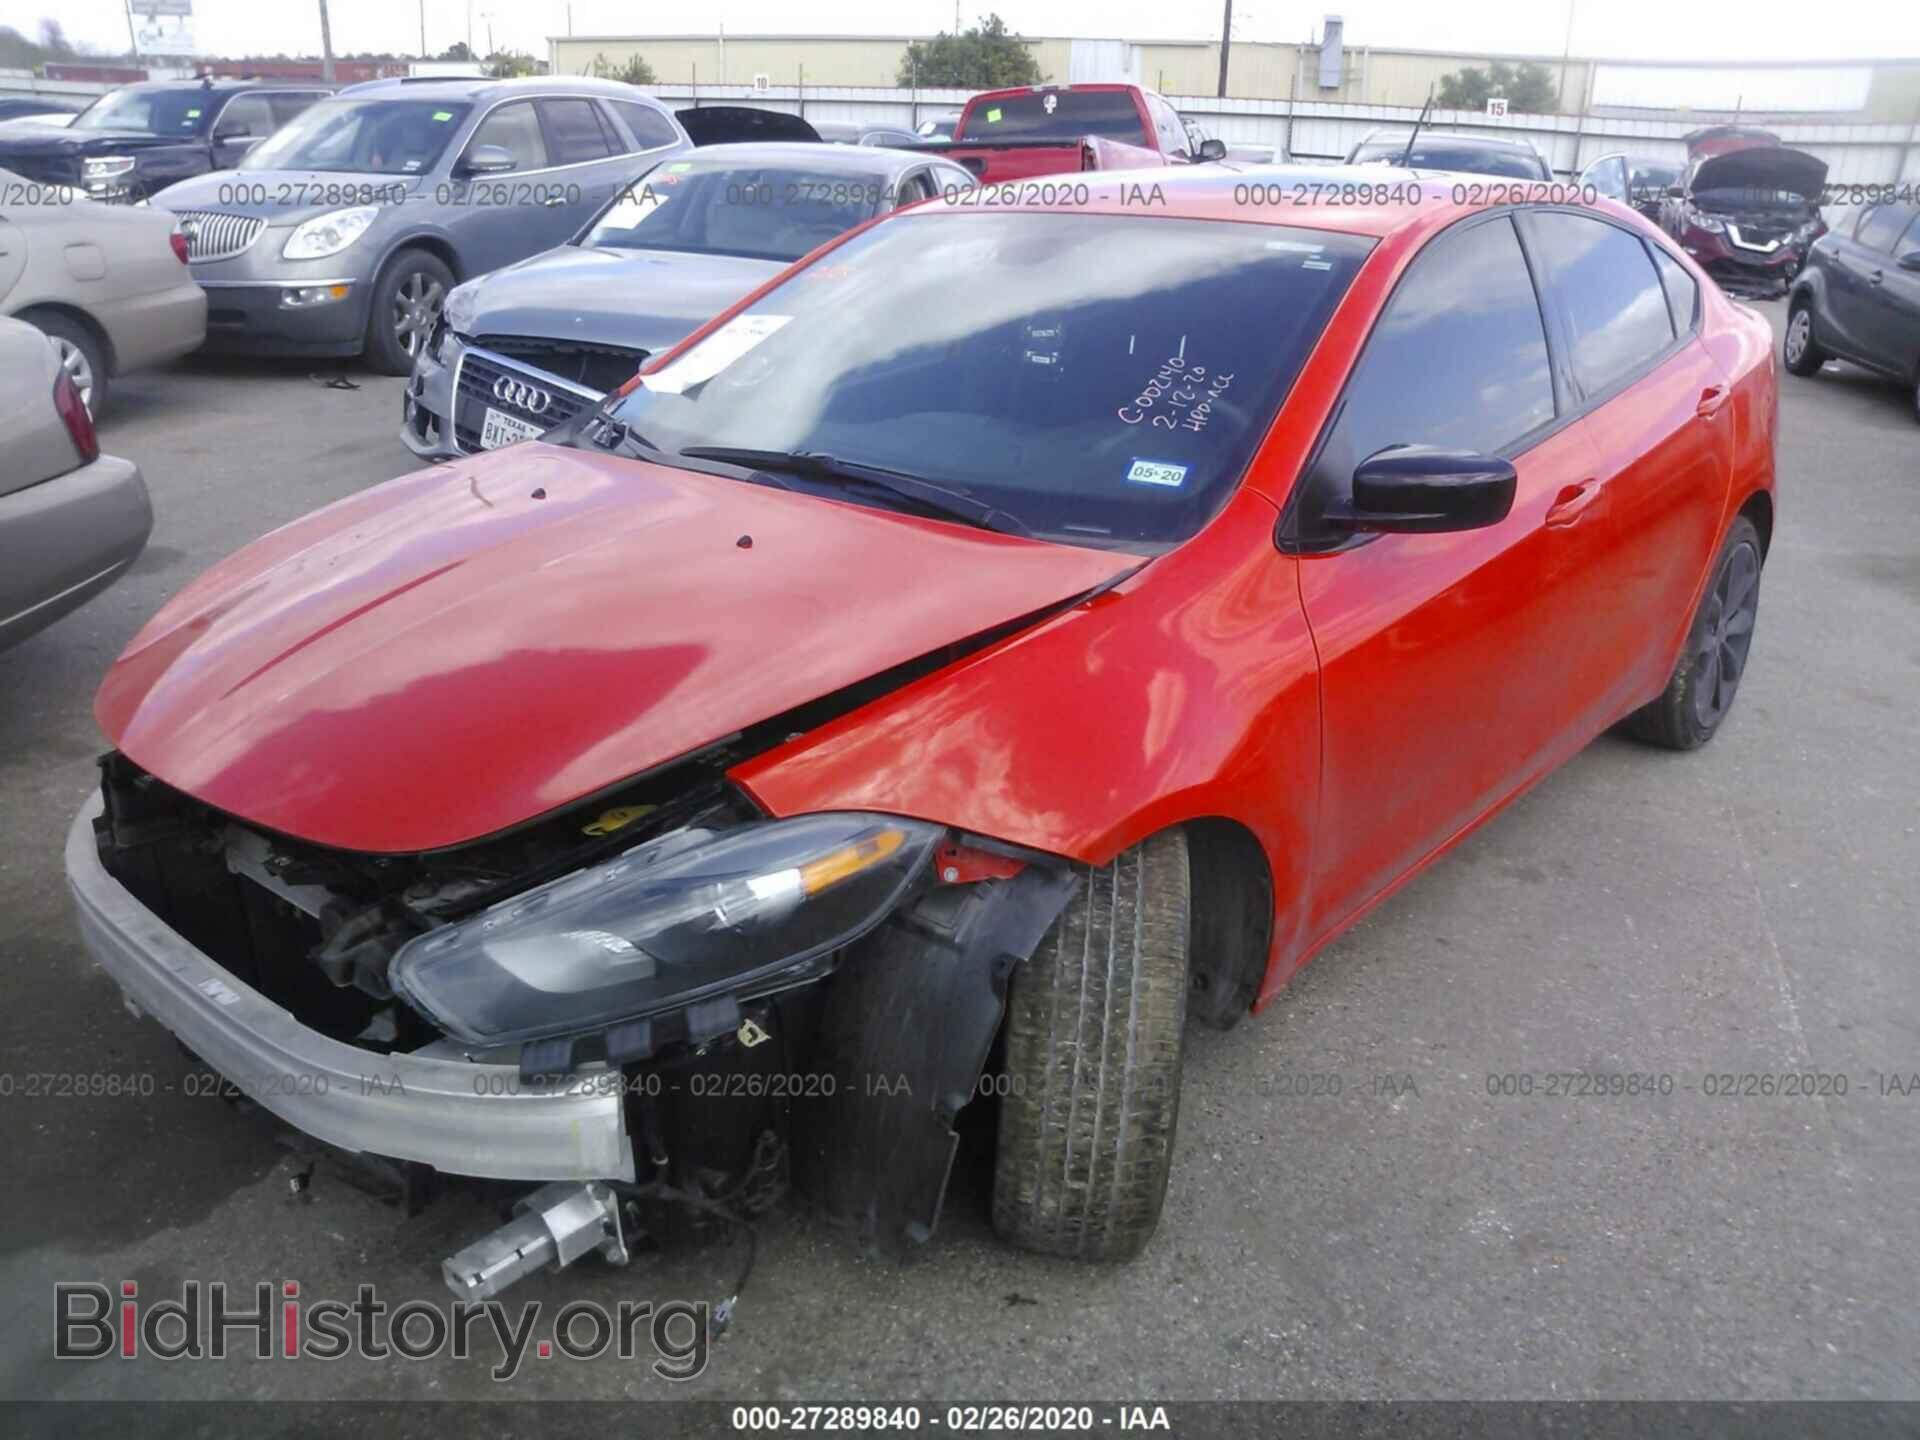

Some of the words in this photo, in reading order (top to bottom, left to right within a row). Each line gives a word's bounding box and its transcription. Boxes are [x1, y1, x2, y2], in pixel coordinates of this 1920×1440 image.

[756, 77, 768, 90] 10
[1490, 102, 1505, 117] 15
[504, 417, 527, 433] TEXAS
